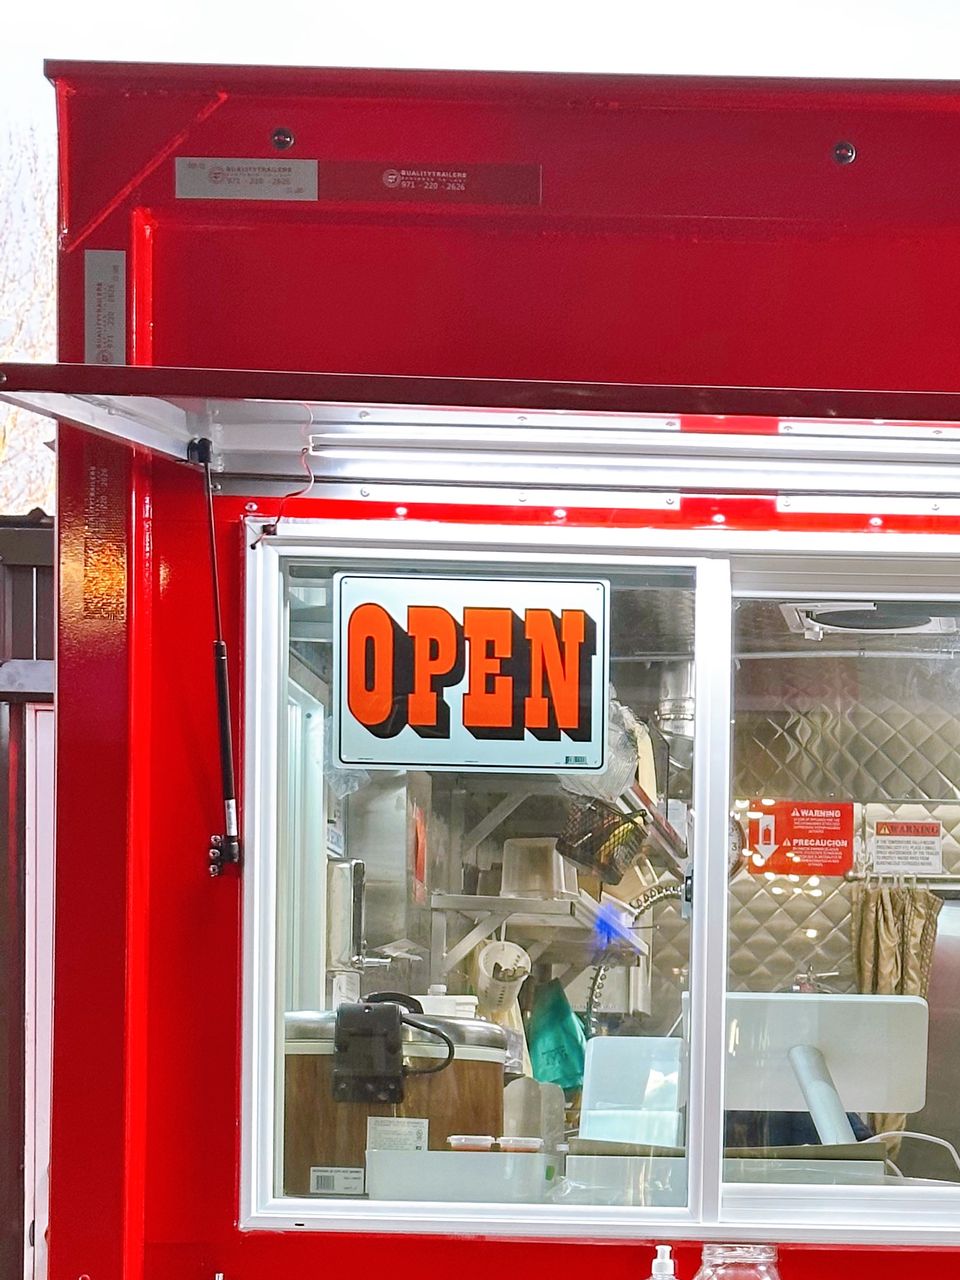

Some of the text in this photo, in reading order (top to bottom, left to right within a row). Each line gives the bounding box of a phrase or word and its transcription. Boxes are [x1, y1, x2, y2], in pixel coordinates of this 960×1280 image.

[347, 602, 597, 742] OPEN
[800, 810, 841, 818] WARNING
[889, 825, 939, 834] WARNING
[793, 839, 848, 847] PRECAUCION
